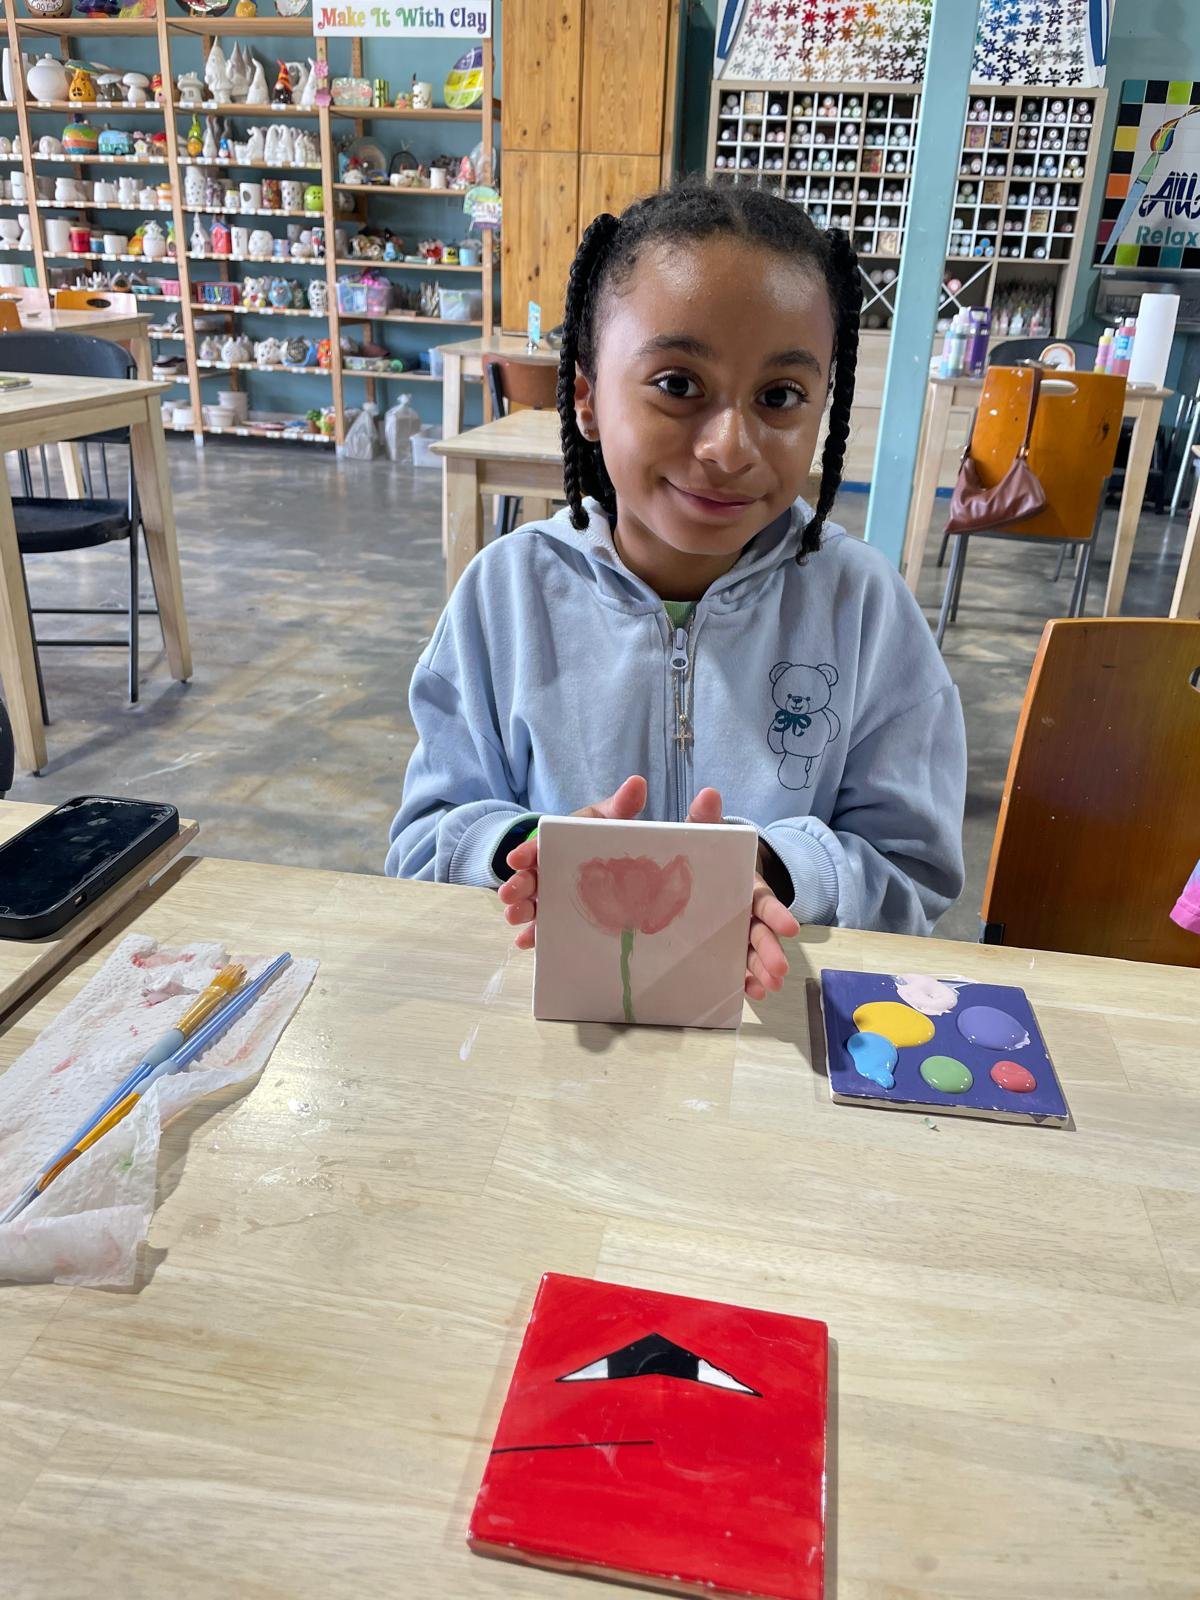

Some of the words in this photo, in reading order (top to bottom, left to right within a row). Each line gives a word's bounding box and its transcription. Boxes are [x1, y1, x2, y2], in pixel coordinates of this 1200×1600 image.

[317, 6, 366, 29] Make
[370, 7, 391, 27] It
[395, 7, 445, 27] With
[450, 7, 487, 34] Clay
[1135, 225, 1199, 247] Relax
